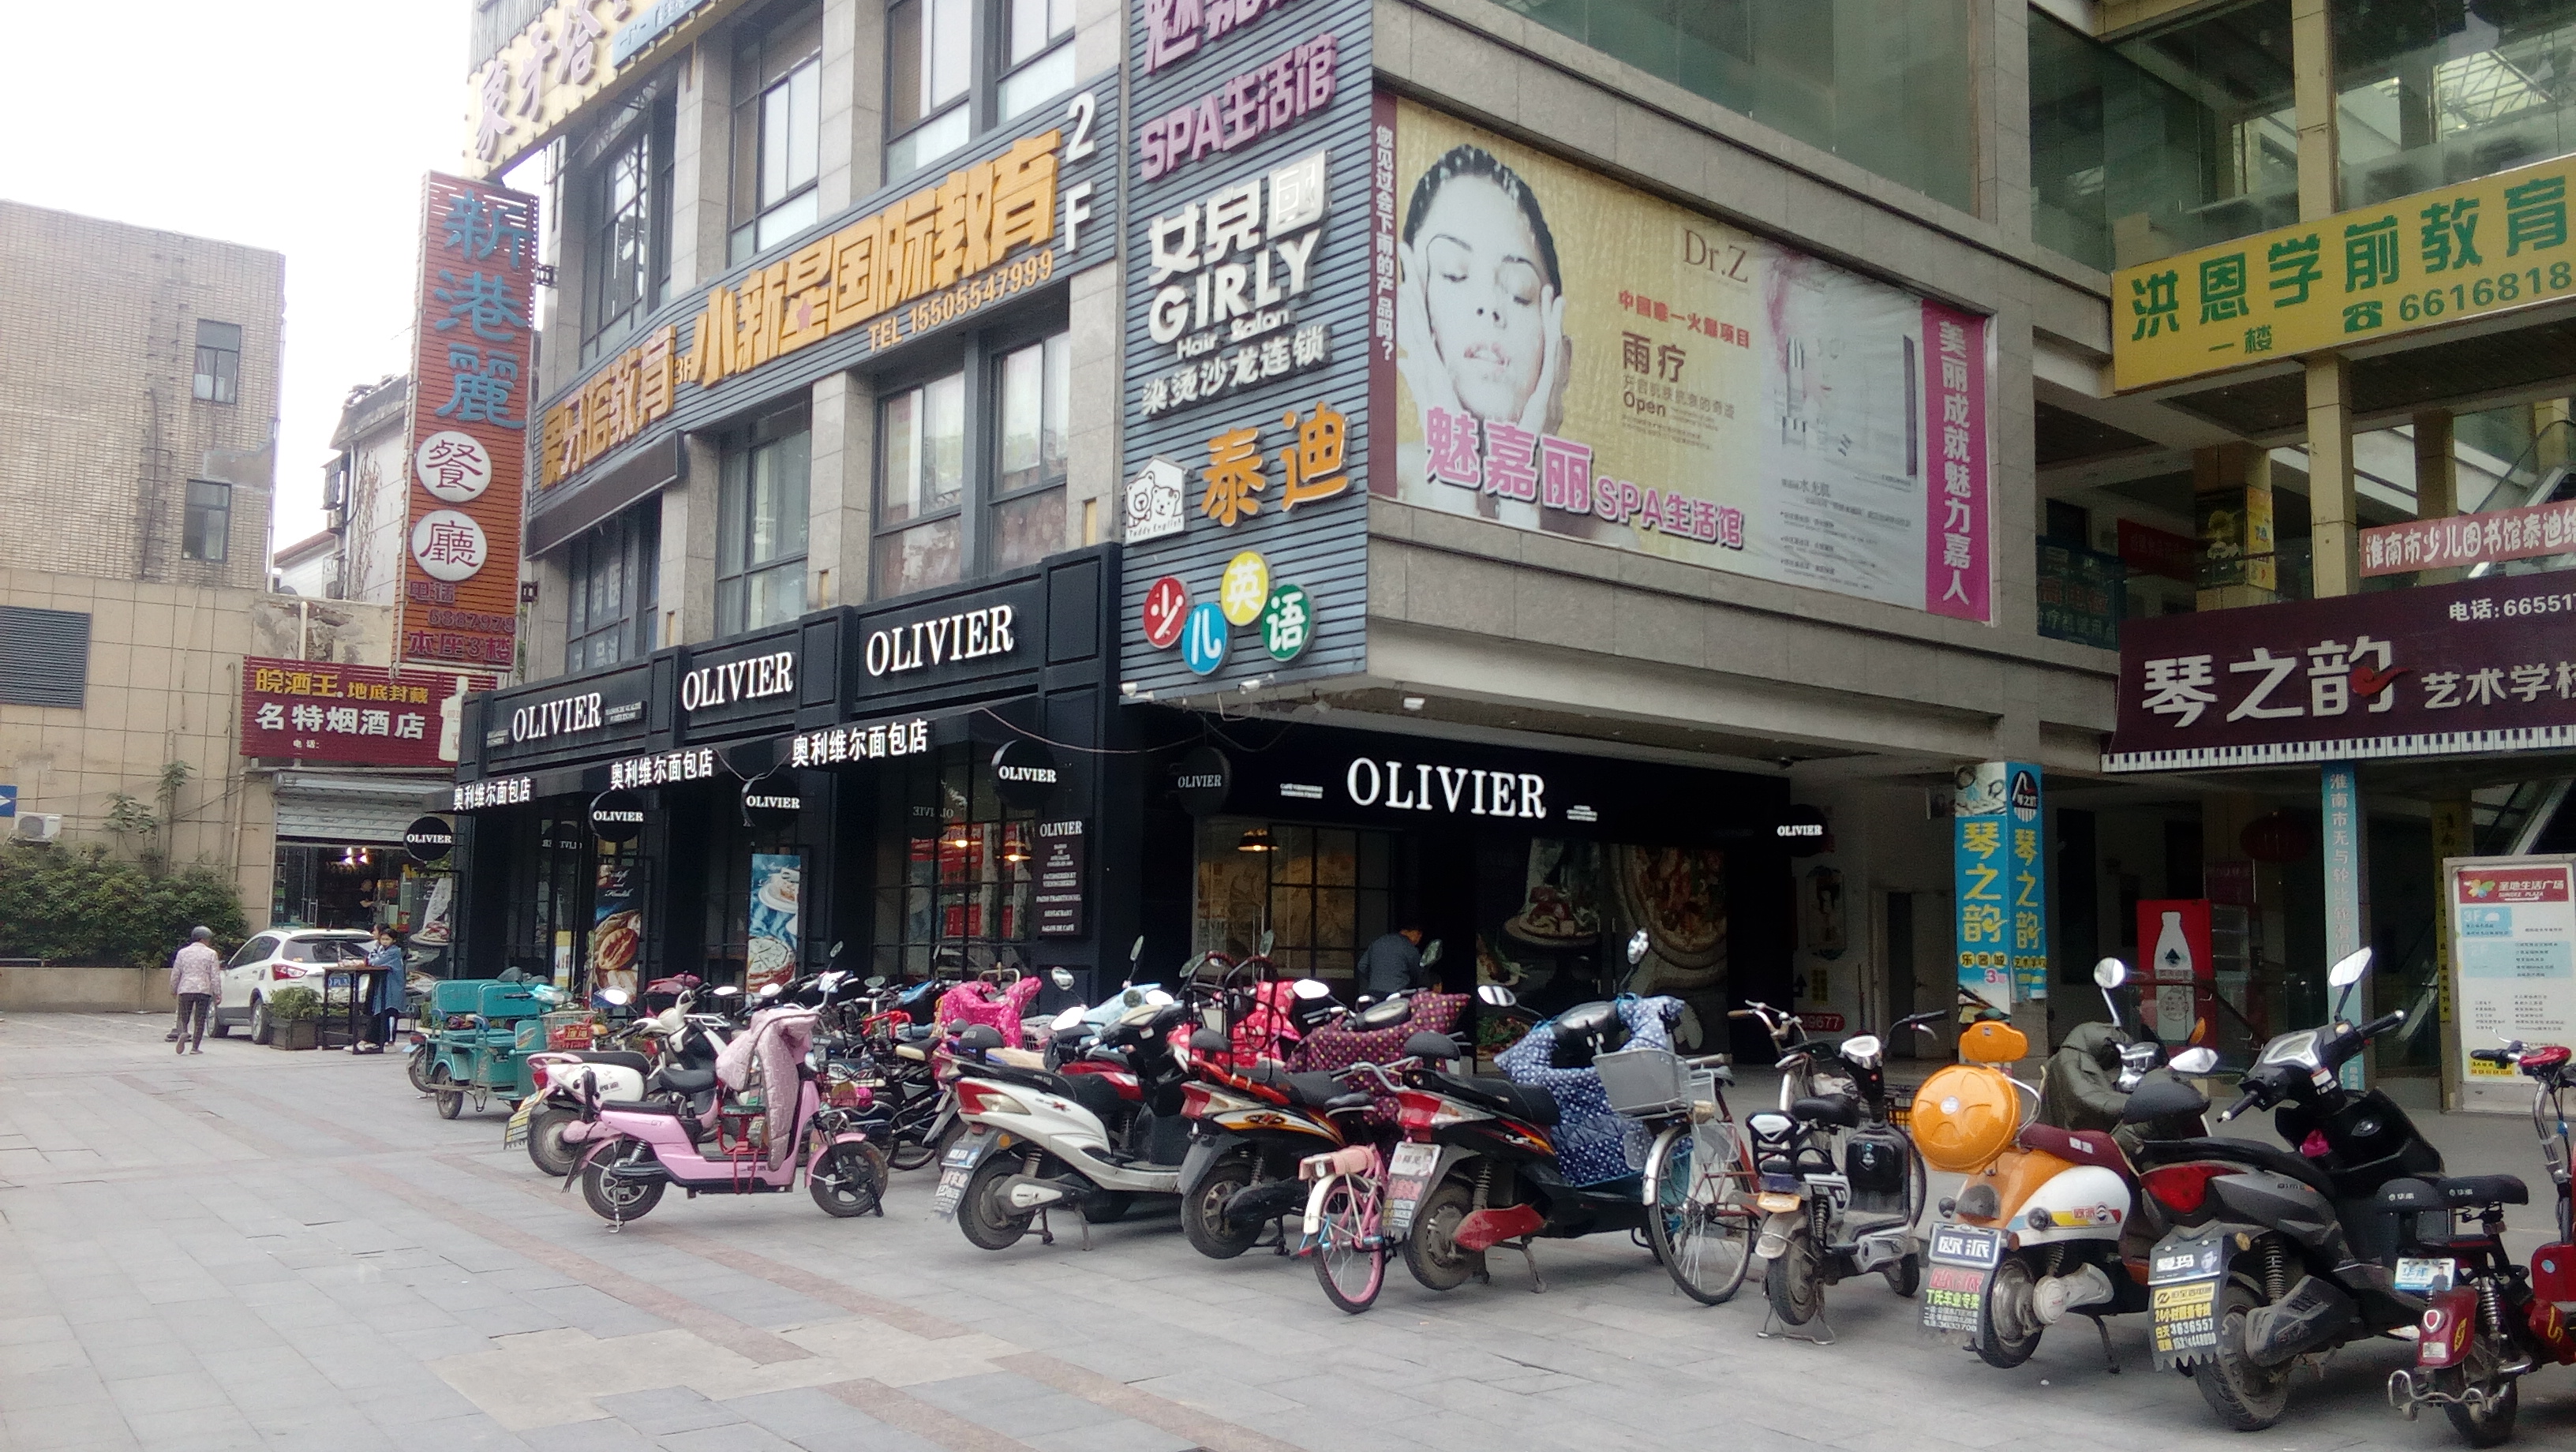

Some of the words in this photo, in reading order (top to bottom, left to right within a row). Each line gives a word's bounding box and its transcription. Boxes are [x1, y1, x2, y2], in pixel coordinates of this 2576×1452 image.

[1141, 32, 1338, 182] SPA生活馆
[691, 128, 1061, 388] 小新星国际教育
[1683, 228, 1749, 283] Dr.Z
[2132, 174, 2568, 342] 洪恩学前教育
[868, 316, 903, 352] TEL
[909, 248, 1054, 335] 15505547999
[1148, 228, 1321, 345] GIRLY
[2399, 260, 2572, 323] 6616818
[1176, 332, 1219, 361] Hair
[1230, 309, 1290, 342] Salon
[2208, 324, 2273, 355] 一楼
[1140, 324, 1327, 416] 染烫沙龙连锁
[1623, 391, 1666, 418] Open
[1201, 401, 1350, 527] 泰迪
[1426, 406, 1593, 514] 魅嘉丽
[1595, 475, 1743, 548] SPA生活馆
[866, 604, 1015, 677] OLIVIER
[1149, 559, 1306, 667] 少儿英语
[682, 651, 793, 712] OLIVIER
[2142, 636, 2401, 728] 琴之韵
[254, 702, 426, 740] 名特烟酒店
[513, 691, 601, 743] OLIVIER
[792, 717, 928, 769] 奥利维尔面包店
[453, 776, 532, 811] 奥利维尔面包店
[610, 747, 714, 791] 奥利维尔面包店
[998, 765, 1058, 784] OLIVIER
[1178, 774, 1222, 788] OLIVIER
[1346, 757, 1547, 819] OLIVIER
[593, 810, 644, 822] OLIVIER
[746, 795, 801, 810] OLIVIER
[1039, 821, 1083, 837] OLIVIER
[1777, 825, 1823, 837] OLIVIER
[406, 833, 452, 844] OLIVIER
[1962, 821, 2008, 943] 琴之韵
[2330, 773, 2352, 997] 淮南市无与轮比轮滑俱
